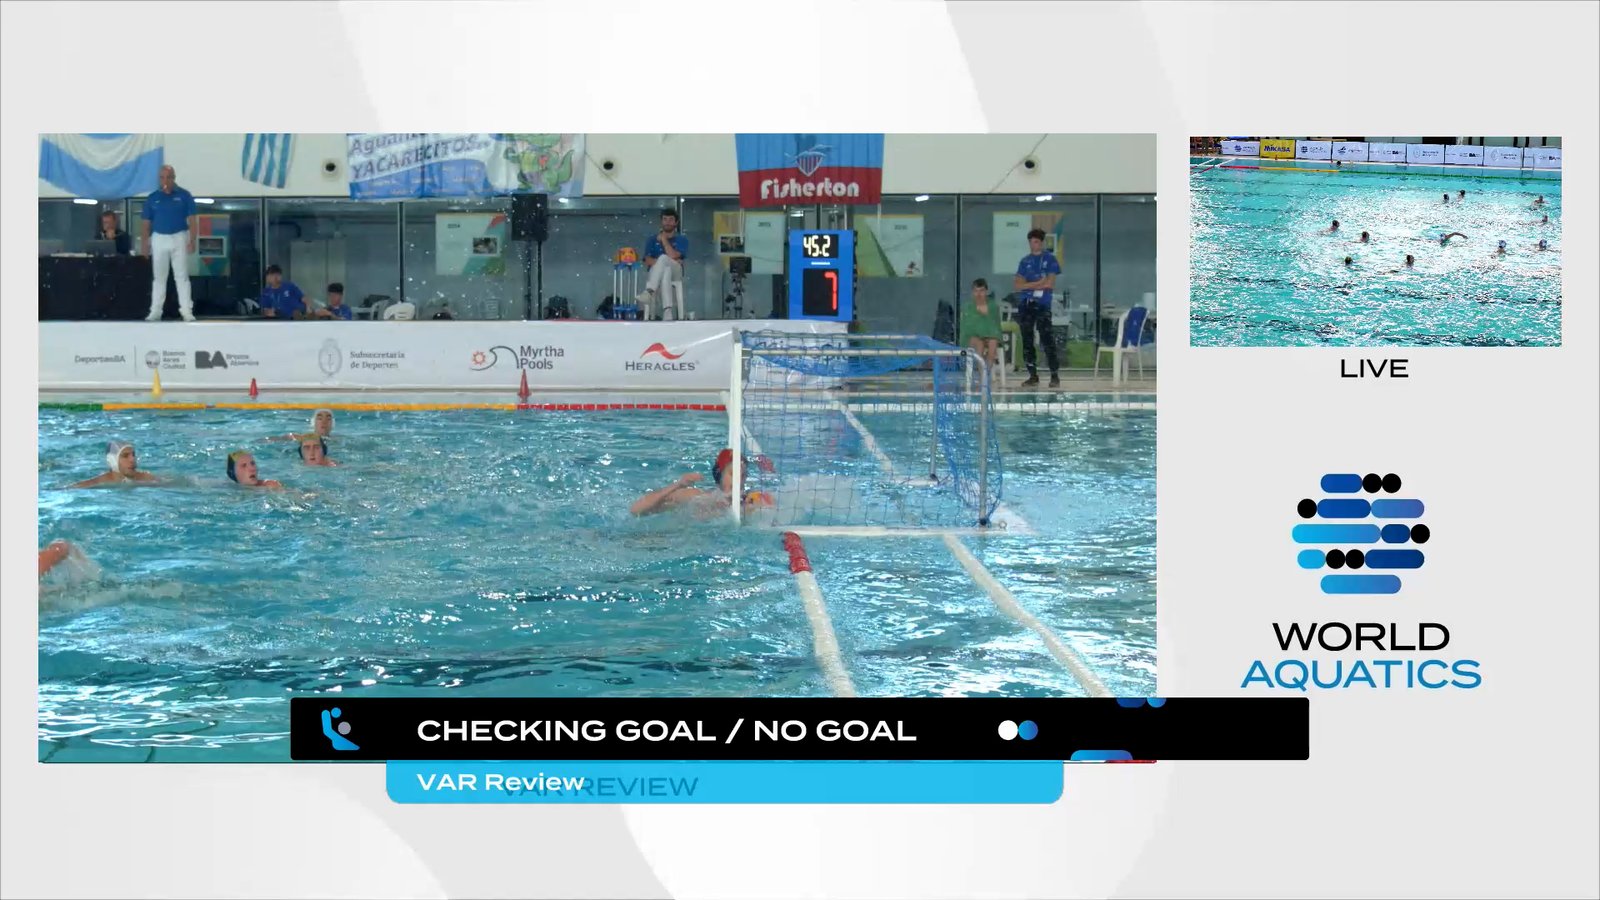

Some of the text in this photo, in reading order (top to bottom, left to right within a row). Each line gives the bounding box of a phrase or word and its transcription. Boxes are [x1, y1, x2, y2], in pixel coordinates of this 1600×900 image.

[760, 177, 860, 200] Fisherton
[803, 234, 831, 257] 45.2
[824, 271, 838, 311] 7
[195, 350, 228, 369] BA
[520, 345, 565, 360] Myrtha
[350, 360, 399, 371] de Deportes
[520, 358, 554, 370] Pools
